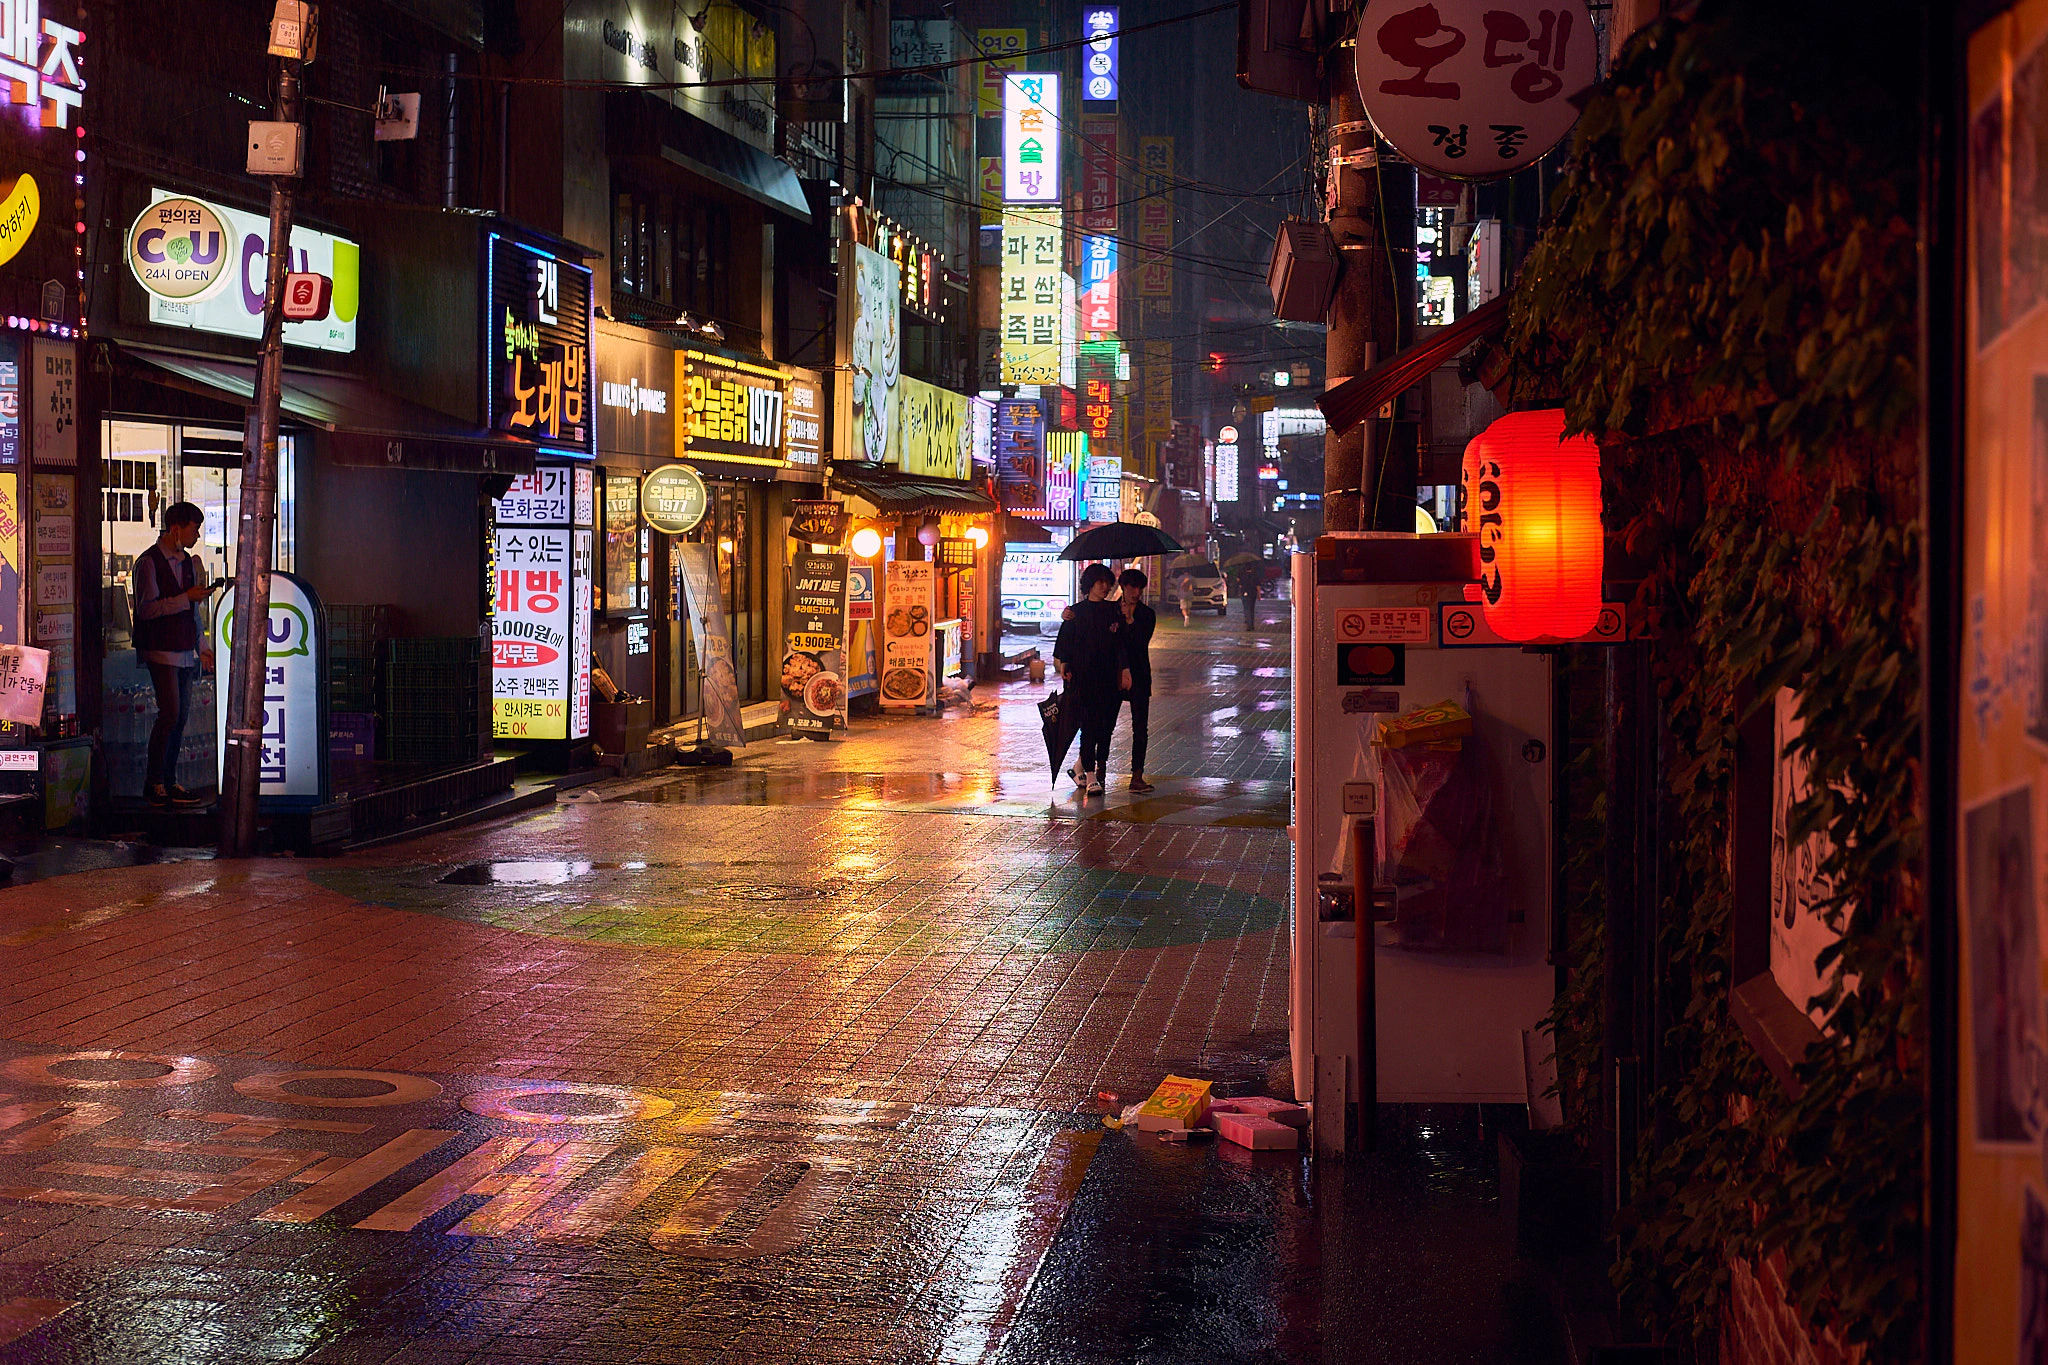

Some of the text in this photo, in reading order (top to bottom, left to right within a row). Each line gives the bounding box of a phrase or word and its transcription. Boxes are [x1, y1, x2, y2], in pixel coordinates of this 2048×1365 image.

[1377, 3, 1573, 104] 오뎅
[1019, 78, 1043, 195] 청춘술방
[1427, 124, 1529, 159] 정종
[158, 209, 201, 224] 편의점
[1086, 217, 1113, 227] Cafe
[137, 228, 219, 265] CU
[1008, 235, 1055, 265] 파전
[145, 269, 209, 281] 24시 OPEN
[537, 259, 558, 326] 캔
[1008, 275, 1055, 304] 보쌈
[1008, 315, 1055, 345] 족발
[1009, 366, 1055, 381] 김삿갓
[511, 345, 586, 439] 노래방
[602, 377, 667, 417] ALWAYS 5 PROMISE
[749, 386, 783, 448] 1977
[1092, 430, 1106, 438] B1
[1006, 431, 1037, 504] 노래방
[499, 499, 566, 520] 문화공간
[658, 499, 688, 512] 1977
[506, 535, 563, 562] 수 있는
[1015, 563, 1053, 575] 써비스
[796, 579, 841, 592] JMT세트
[832, 607, 840, 615] M
[1369, 613, 1421, 625] 금연구역
[794, 635, 835, 648] 9,900원
[889, 657, 924, 667] 해물파전
[1348, 675, 1394, 683] mastercard
[505, 702, 542, 717] 안시켜도
[546, 704, 561, 717] OK
[512, 722, 527, 735] OK
[4, 754, 35, 762] 금연구역
